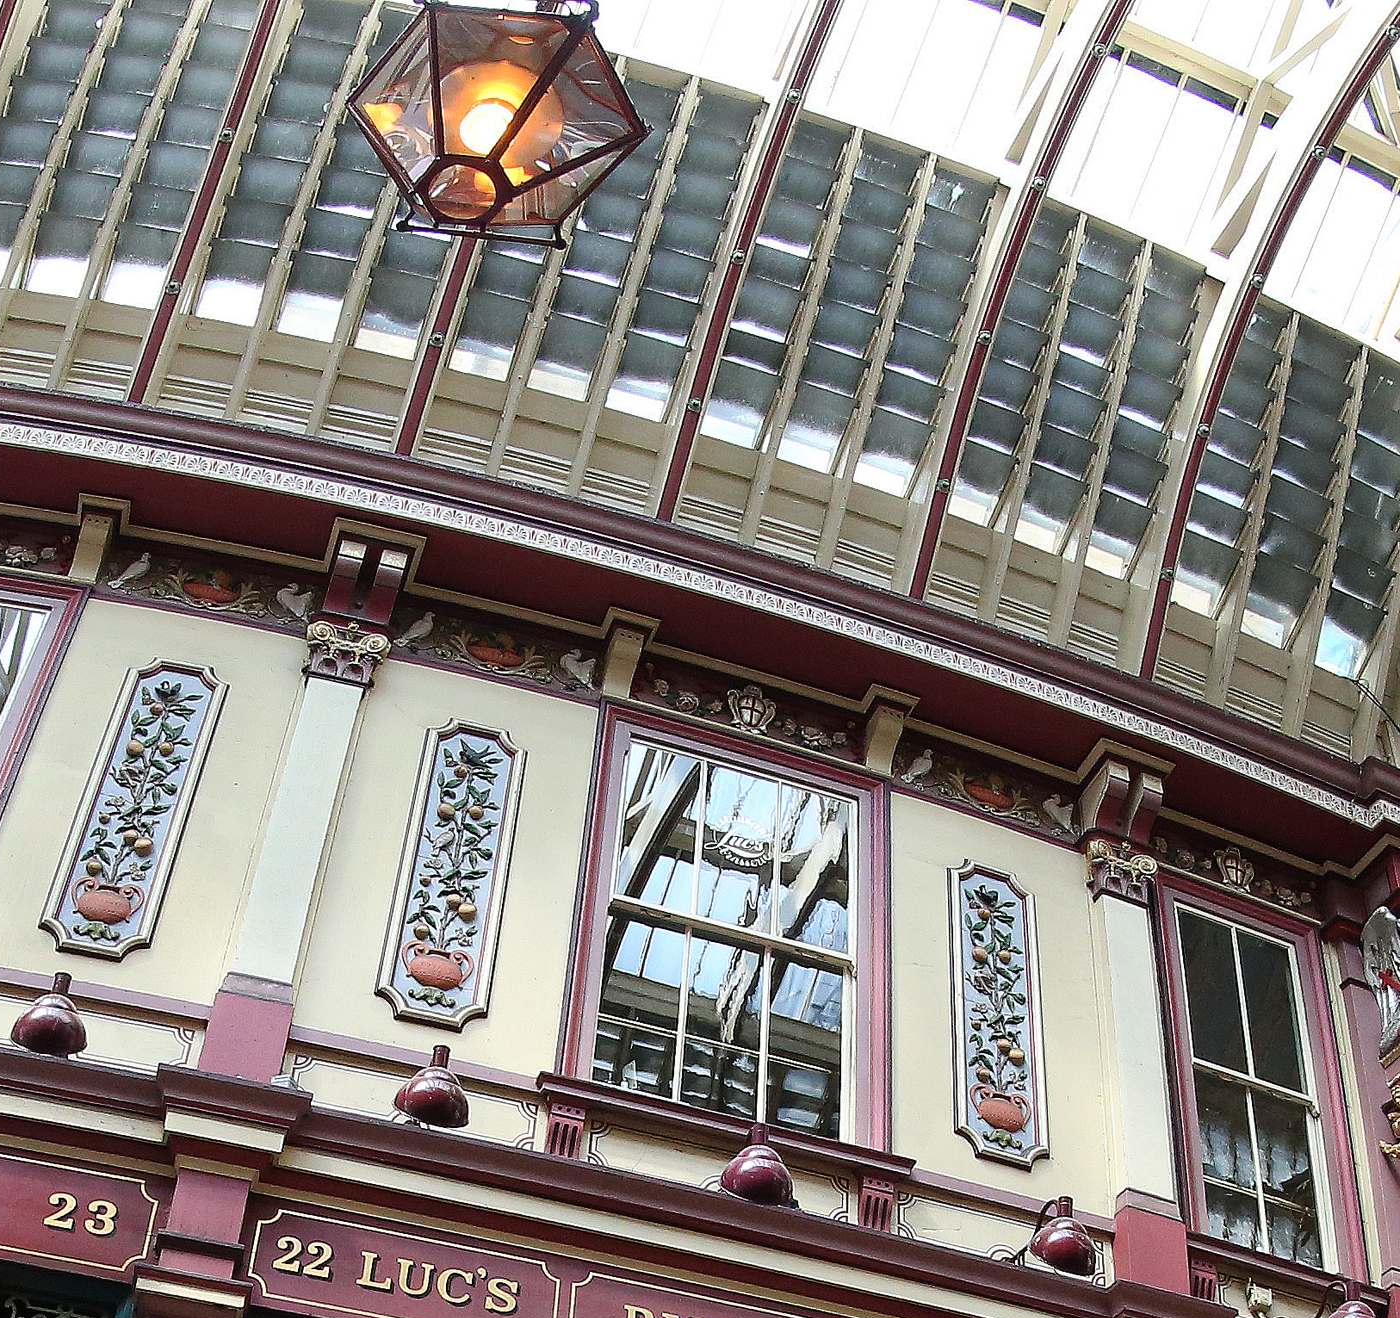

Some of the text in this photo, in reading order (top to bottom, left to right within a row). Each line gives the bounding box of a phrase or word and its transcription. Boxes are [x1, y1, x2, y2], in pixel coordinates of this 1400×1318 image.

[42, 1192, 118, 1236] 23
[272, 1236, 521, 1314] 22 LUC'S
